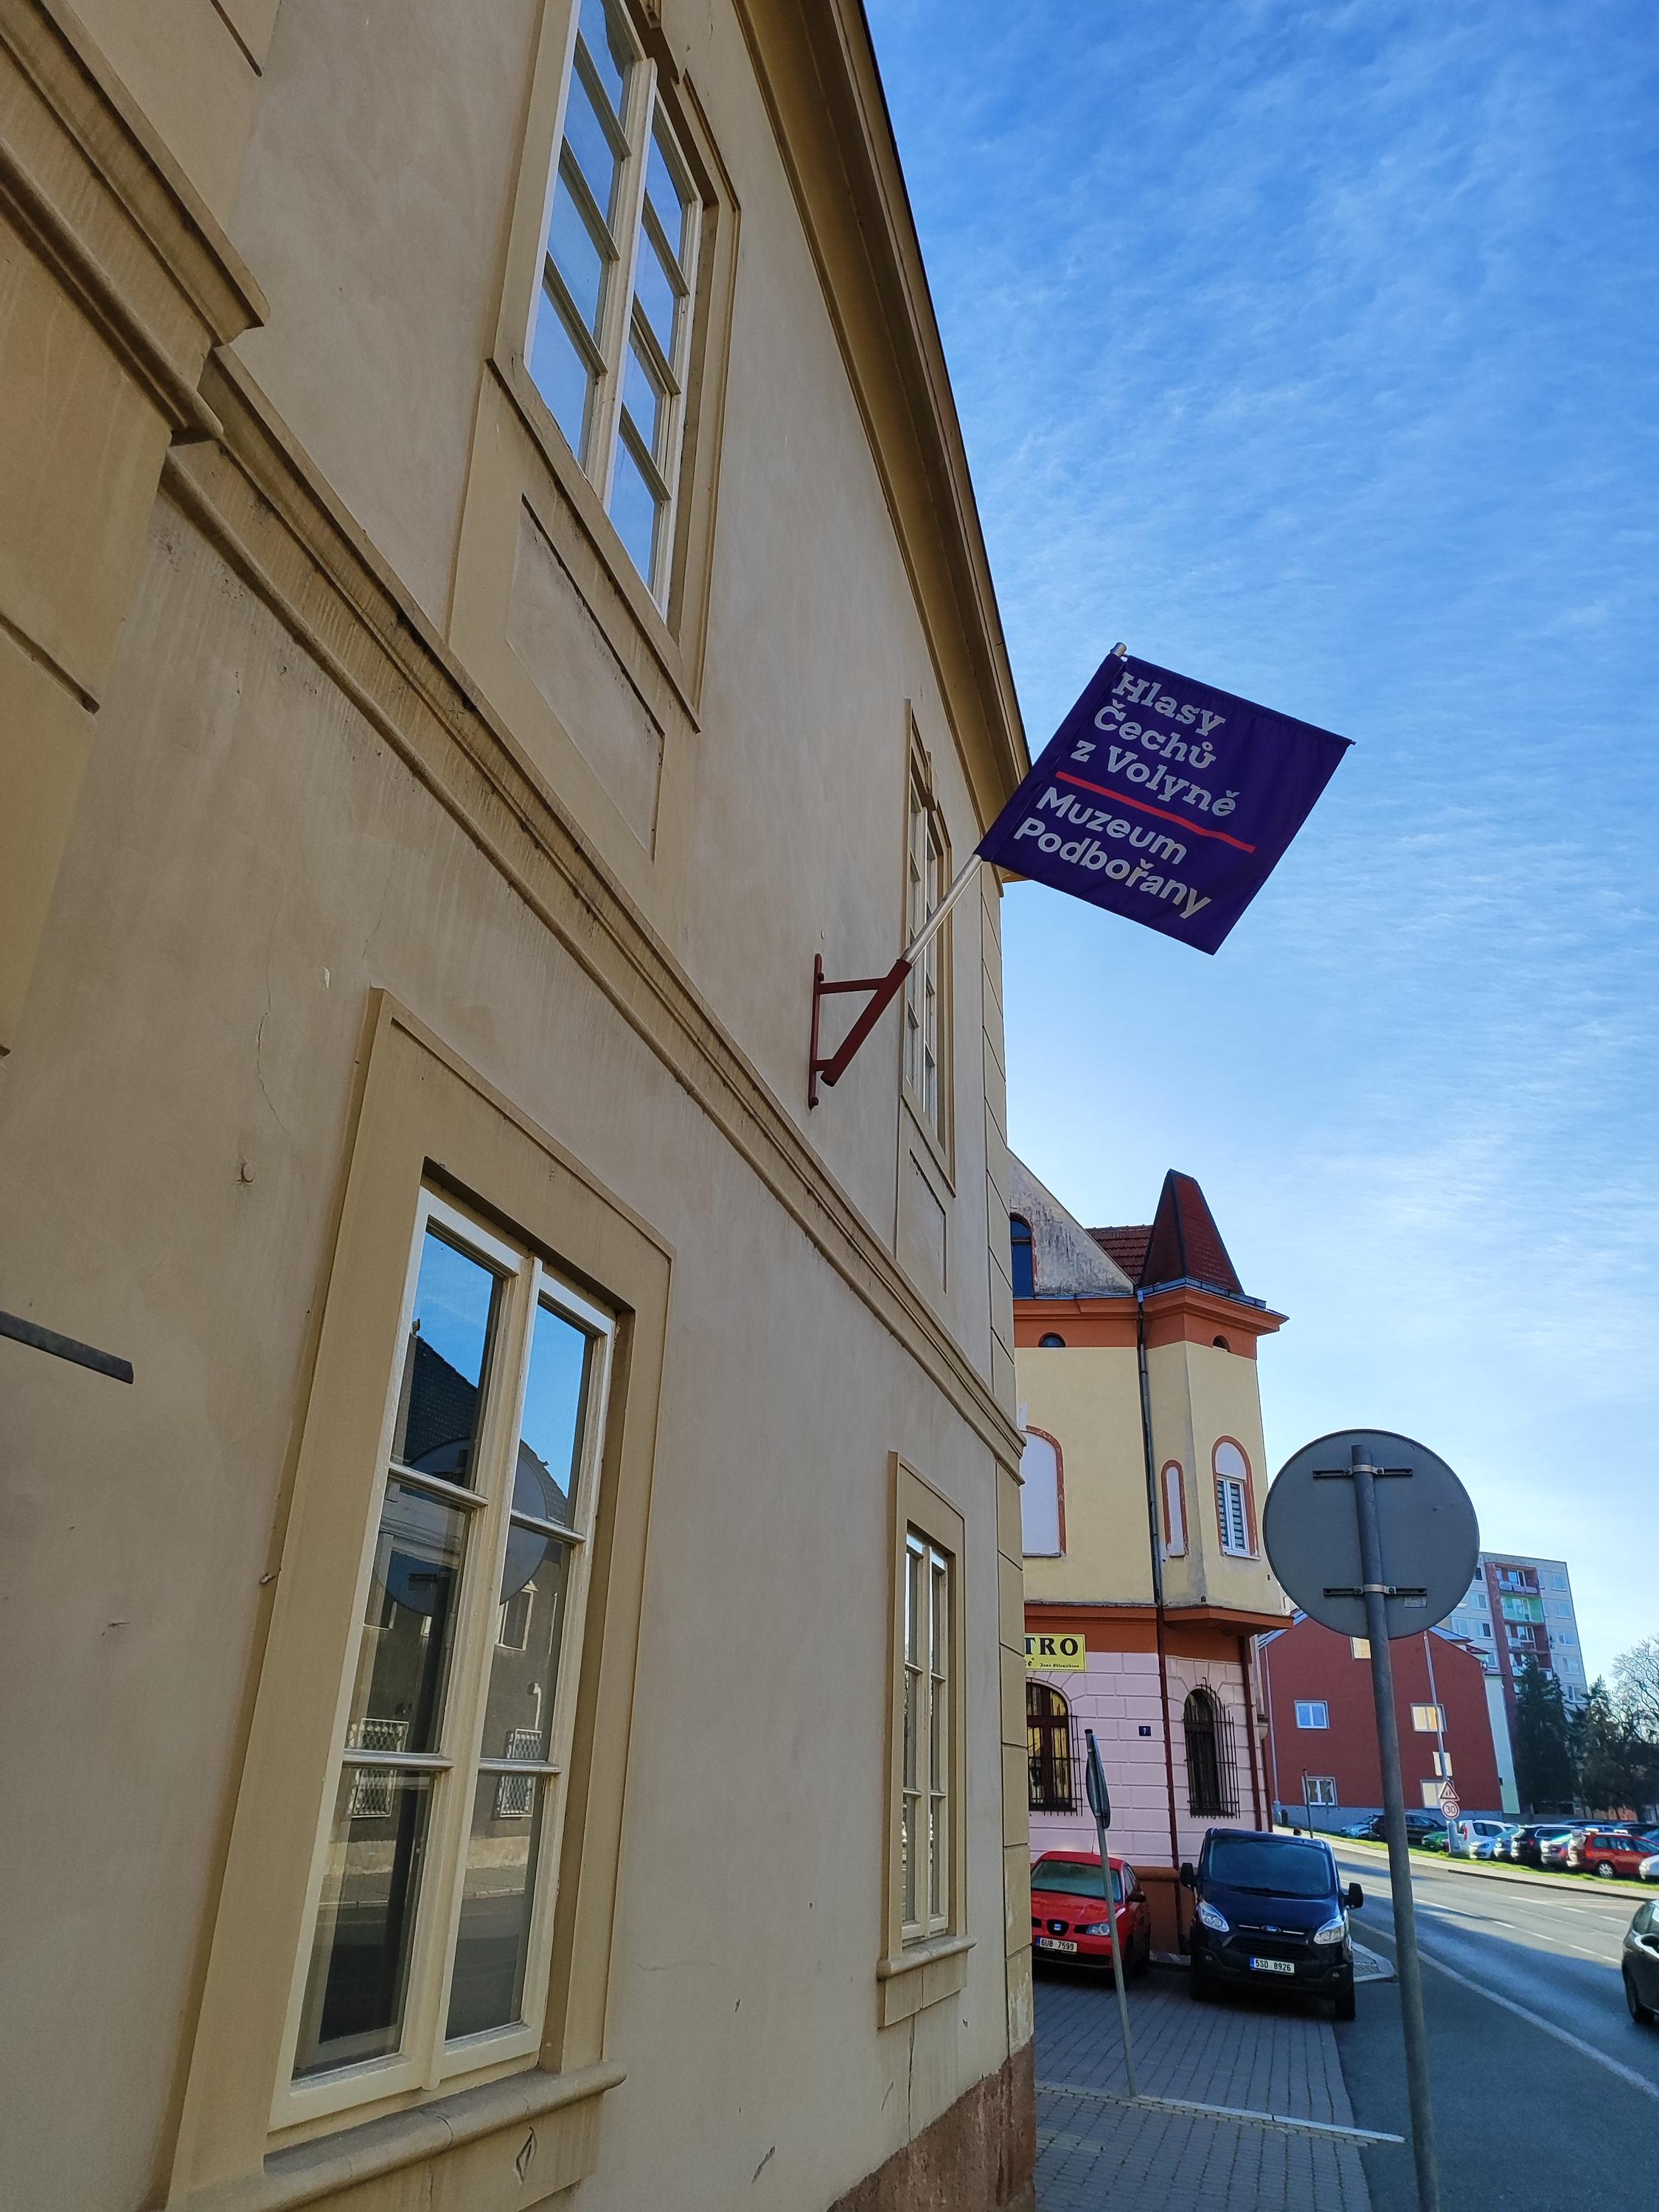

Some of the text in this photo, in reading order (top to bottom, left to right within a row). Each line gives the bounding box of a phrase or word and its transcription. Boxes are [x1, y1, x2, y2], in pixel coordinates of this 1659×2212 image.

[1094, 698, 1217, 769] Čechů
[1112, 672, 1225, 737] Hlasy
[1071, 740, 1240, 816] z Volyně
[1037, 787, 1187, 865] Muzeum
[1014, 817, 1211, 919] Podbořany
[1024, 1637, 1079, 1656] TRO
[1445, 1805, 1456, 1814] 30
